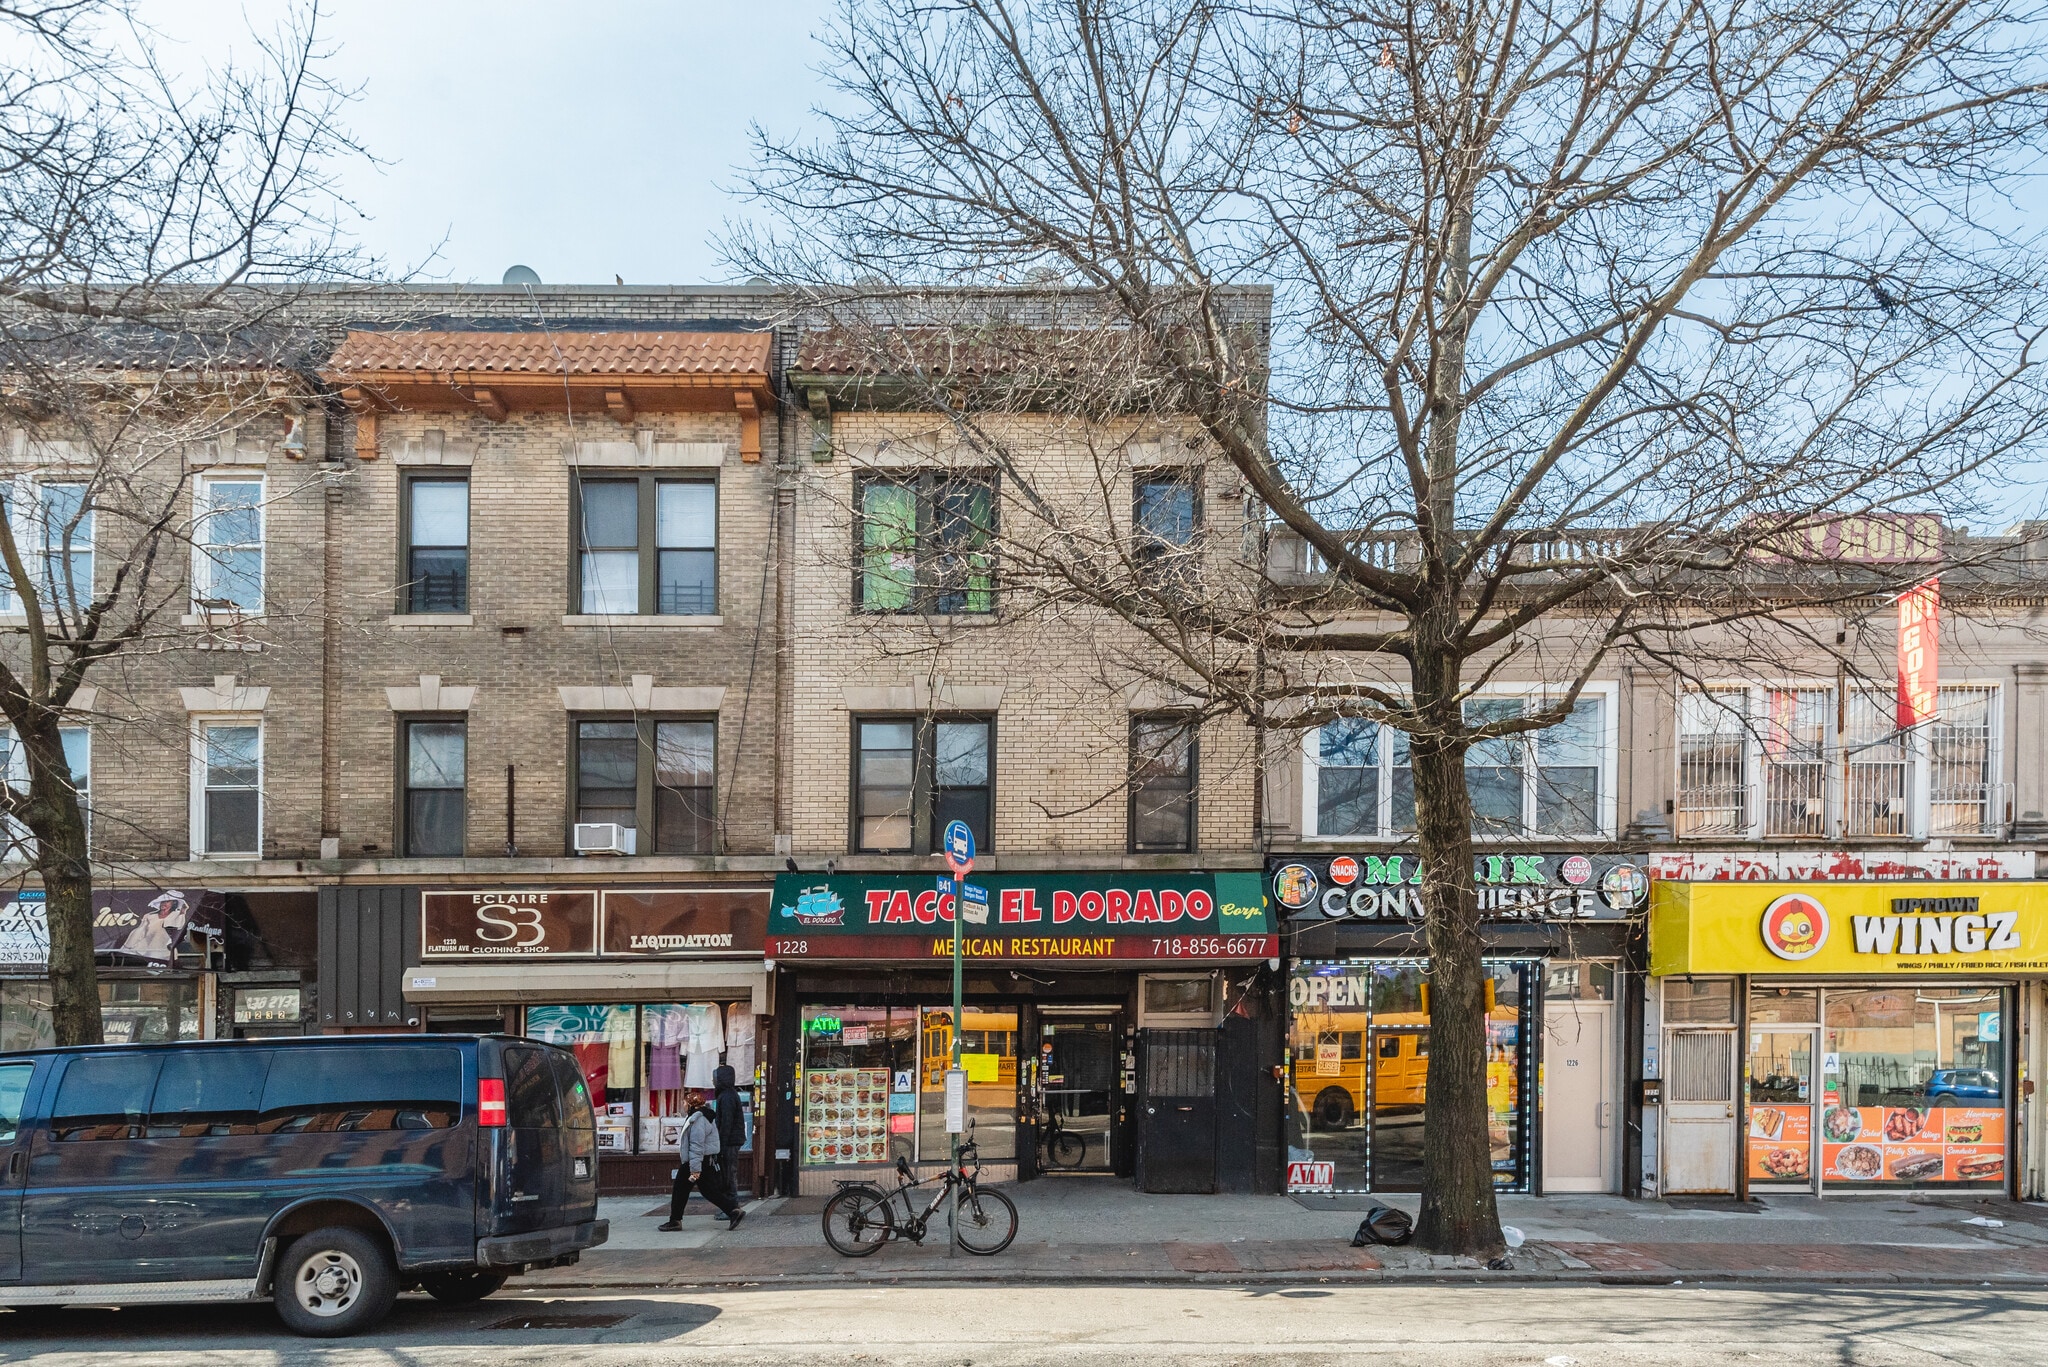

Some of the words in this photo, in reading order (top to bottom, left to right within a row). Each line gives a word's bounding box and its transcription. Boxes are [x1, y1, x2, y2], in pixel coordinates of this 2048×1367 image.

[1840, 517, 1939, 559] GOLD
[1900, 587, 1935, 629] BUY
[1903, 625, 1932, 718] GOLD
[1331, 864, 1358, 878] SNACKS
[1364, 855, 1548, 886] MIK
[1564, 868, 1590, 877] DRINKS
[938, 880, 951, 893] B41
[473, 894, 548, 904] ECLAIRE
[1891, 896, 1979, 913] UPTOWN
[13, 904, 47, 917] FO
[865, 890, 989, 924] TACO
[999, 888, 1042, 924] EL
[1052, 889, 1213, 924] DORADO
[1220, 903, 1262, 919] Corp.
[93, 907, 138, 927] Inc.
[0, 920, 50, 932] REN
[1853, 911, 2022, 954] WINGZ
[631, 933, 733, 950] LIQUIDATION
[775, 940, 808, 953] 1228
[1011, 938, 1115, 956] RESTAURANT
[1152, 938, 1267, 955] 718-856-6677
[472, 946, 521, 954] CLOTHING
[1290, 976, 1367, 1006] OPEN
[245, 1011, 286, 1019] 1232
[812, 1018, 840, 1030] ATM
[1566, 1059, 1579, 1067] 1226
[1825, 1056, 1836, 1067] A
[898, 1074, 908, 1086] A
[1965, 1110, 2002, 1120] Hamburger
[1862, 1129, 1881, 1138] Salad
[1922, 1131, 1940, 1140] Wings
[1886, 1147, 1905, 1156] Philly
[1947, 1147, 1977, 1155] Sandwich
[1290, 1164, 1330, 1184] ATM
